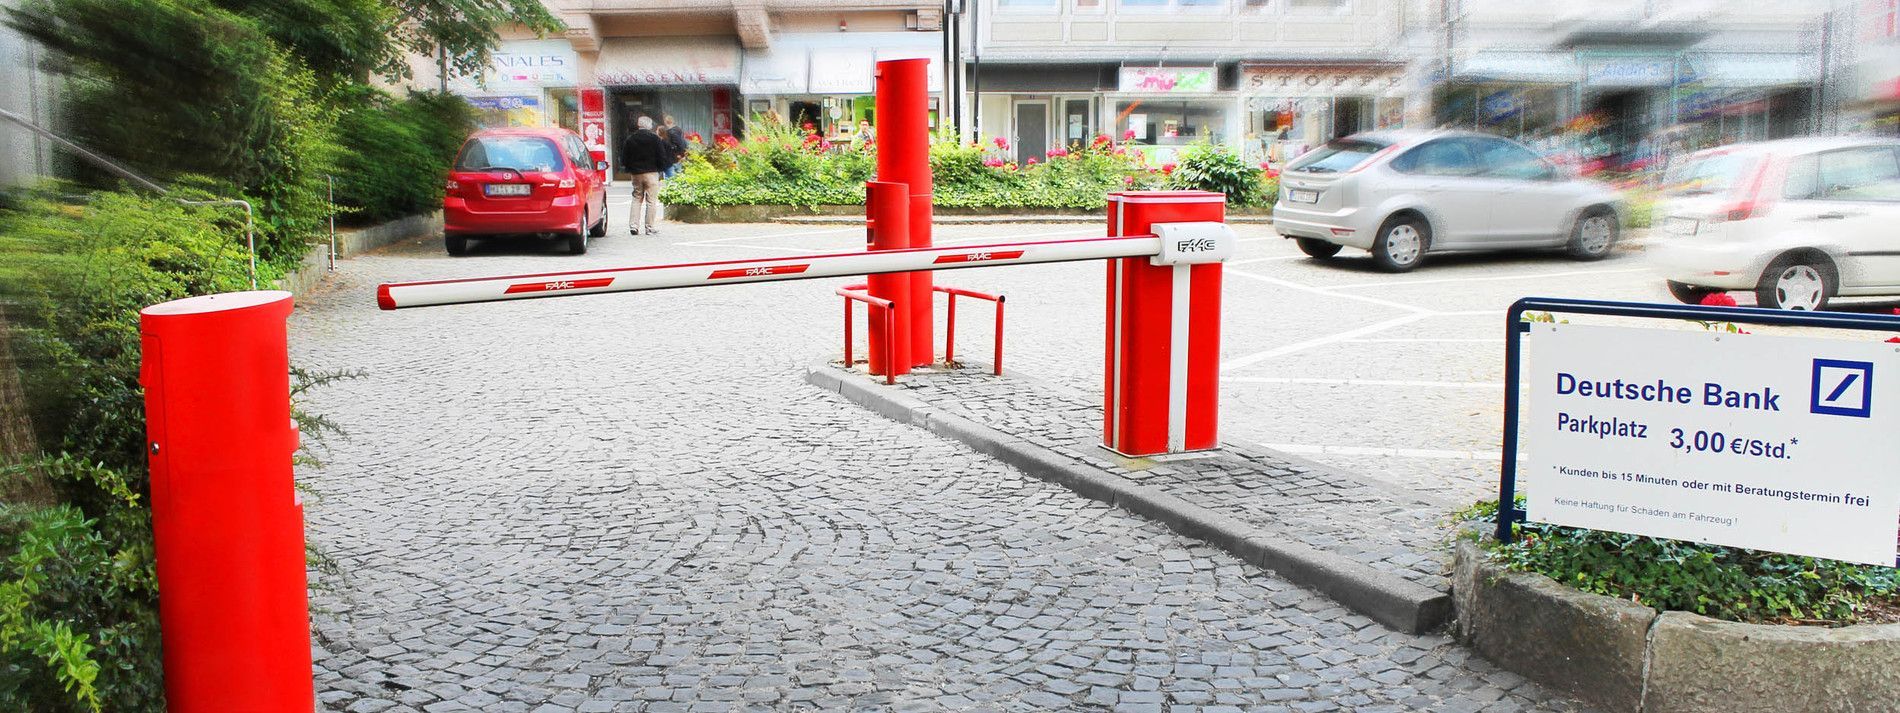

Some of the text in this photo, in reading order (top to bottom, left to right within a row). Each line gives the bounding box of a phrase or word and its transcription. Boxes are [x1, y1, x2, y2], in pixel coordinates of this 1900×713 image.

[598, 73, 706, 85] SALON GENIE
[1177, 238, 1216, 252] FAAC
[967, 252, 992, 261] FAAC
[745, 266, 773, 276] FAAC
[545, 281, 575, 290] FAAC
[1556, 373, 1780, 411] Deutsche Bank
[1557, 412, 1648, 439] Parkplatz
[1669, 428, 1725, 454] 3,00
[1559, 466, 1870, 507] Kunden bis 15 Minuten oder mit Beratungstermin frei
[1554, 496, 1579, 507] Keine
[1581, 500, 1615, 513] Haftung
[1672, 510, 1687, 519] am
[1689, 512, 1732, 526] Fahrzeug
